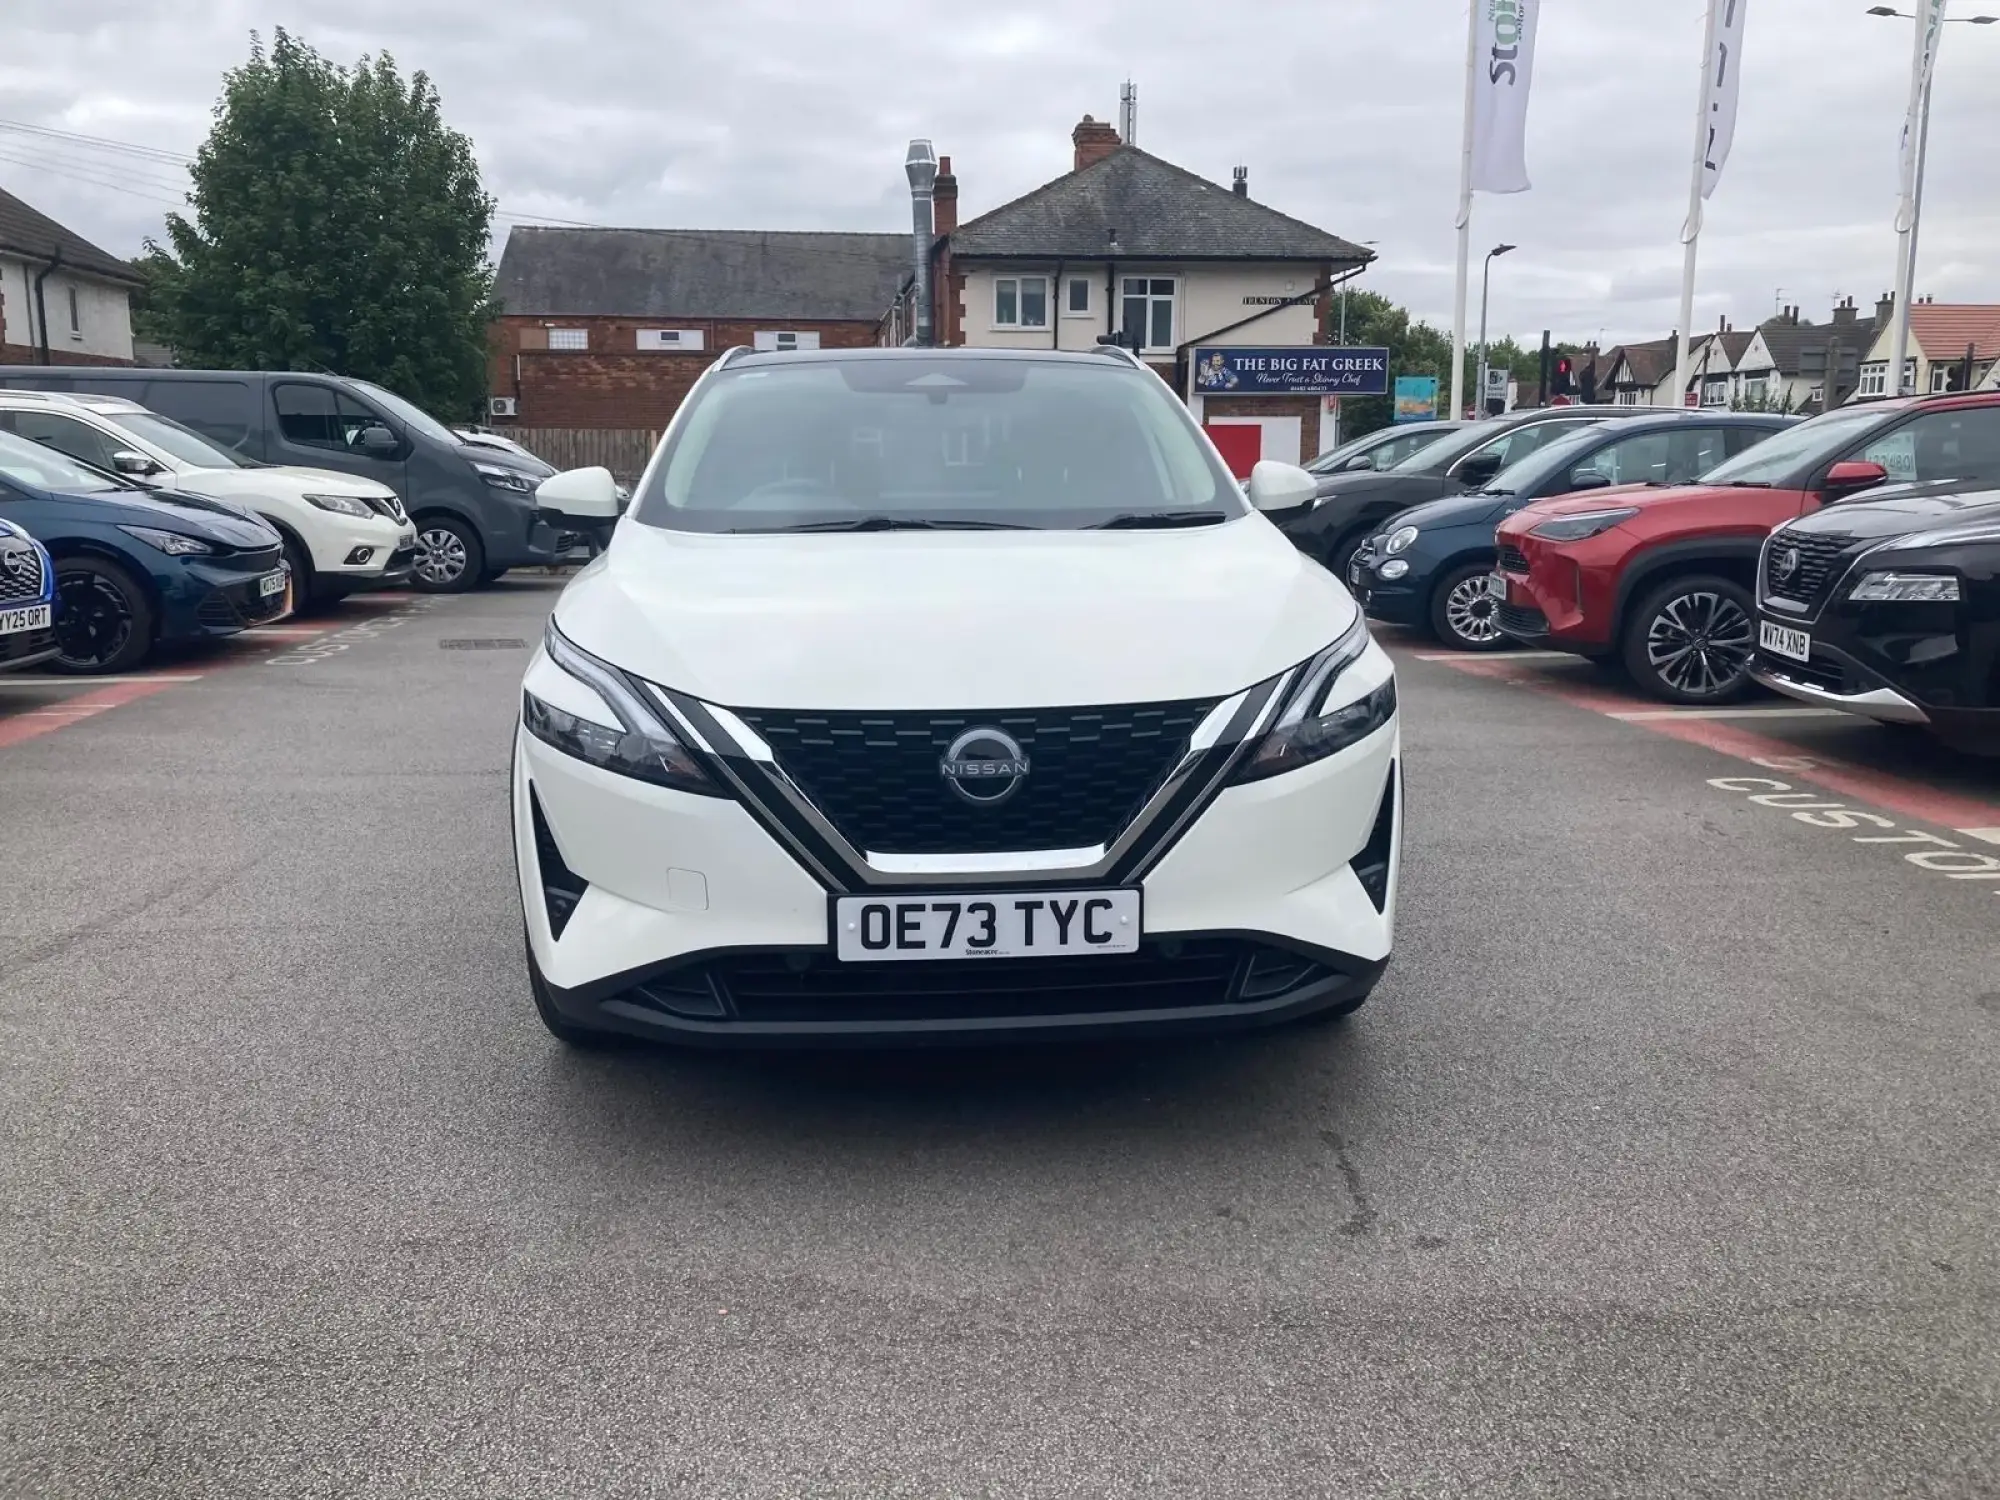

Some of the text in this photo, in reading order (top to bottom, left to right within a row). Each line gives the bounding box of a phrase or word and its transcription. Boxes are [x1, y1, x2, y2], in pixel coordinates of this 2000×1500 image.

[1233, 358, 1384, 371] THE BIG FAT GREEK
[1256, 373, 1281, 383] Never
[1281, 373, 1303, 384] Trust
[1310, 372, 1340, 386] Skinny
[1341, 373, 1362, 386] Chef
[28, 607, 47, 626] ORT
[1786, 630, 1806, 656] XNB
[941, 762, 1028, 775] NISSAN
[860, 898, 1114, 950] OE73 TYC
